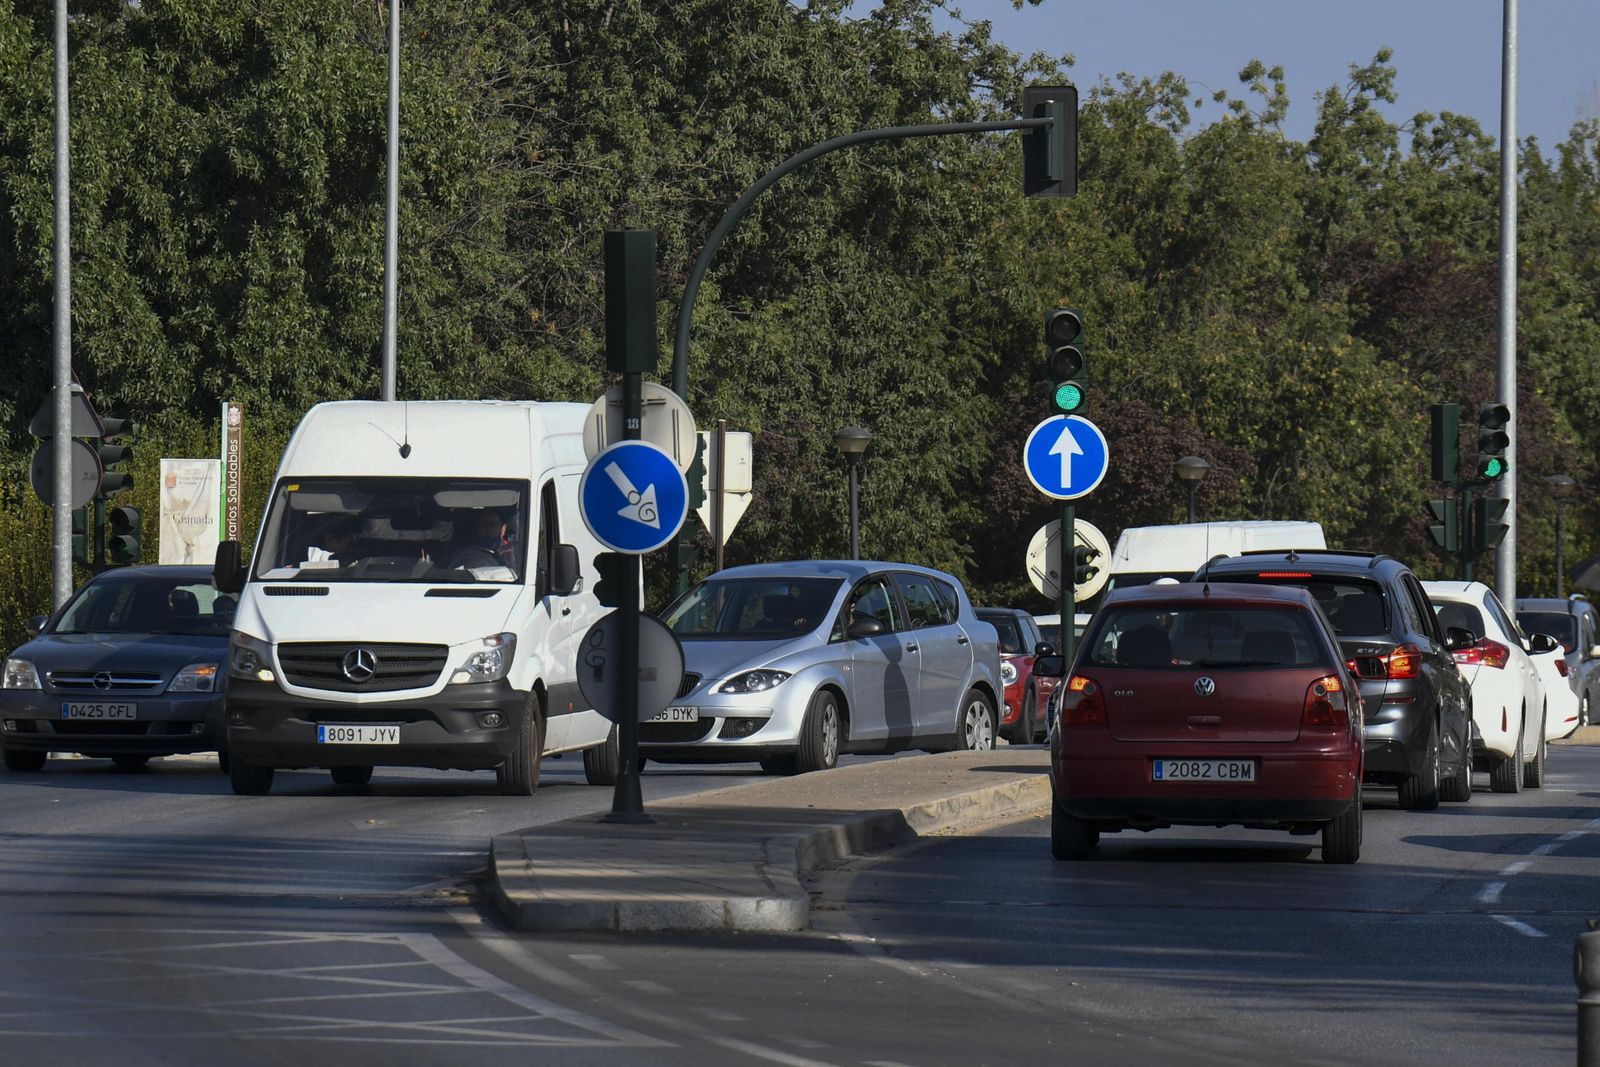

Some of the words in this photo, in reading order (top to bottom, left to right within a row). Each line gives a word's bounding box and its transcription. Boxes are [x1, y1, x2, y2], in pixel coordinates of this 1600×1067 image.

[227, 439, 238, 503] Saludables
[173, 513, 213, 525] Granada
[227, 506, 238, 541] erarios
[70, 705, 104, 718] 0425
[108, 705, 134, 718] CFL
[672, 708, 693, 720] DYK
[328, 728, 362, 741] 8091
[369, 728, 396, 741] JYV
[1169, 762, 1212, 778] 2082
[1217, 763, 1251, 779] CBM
